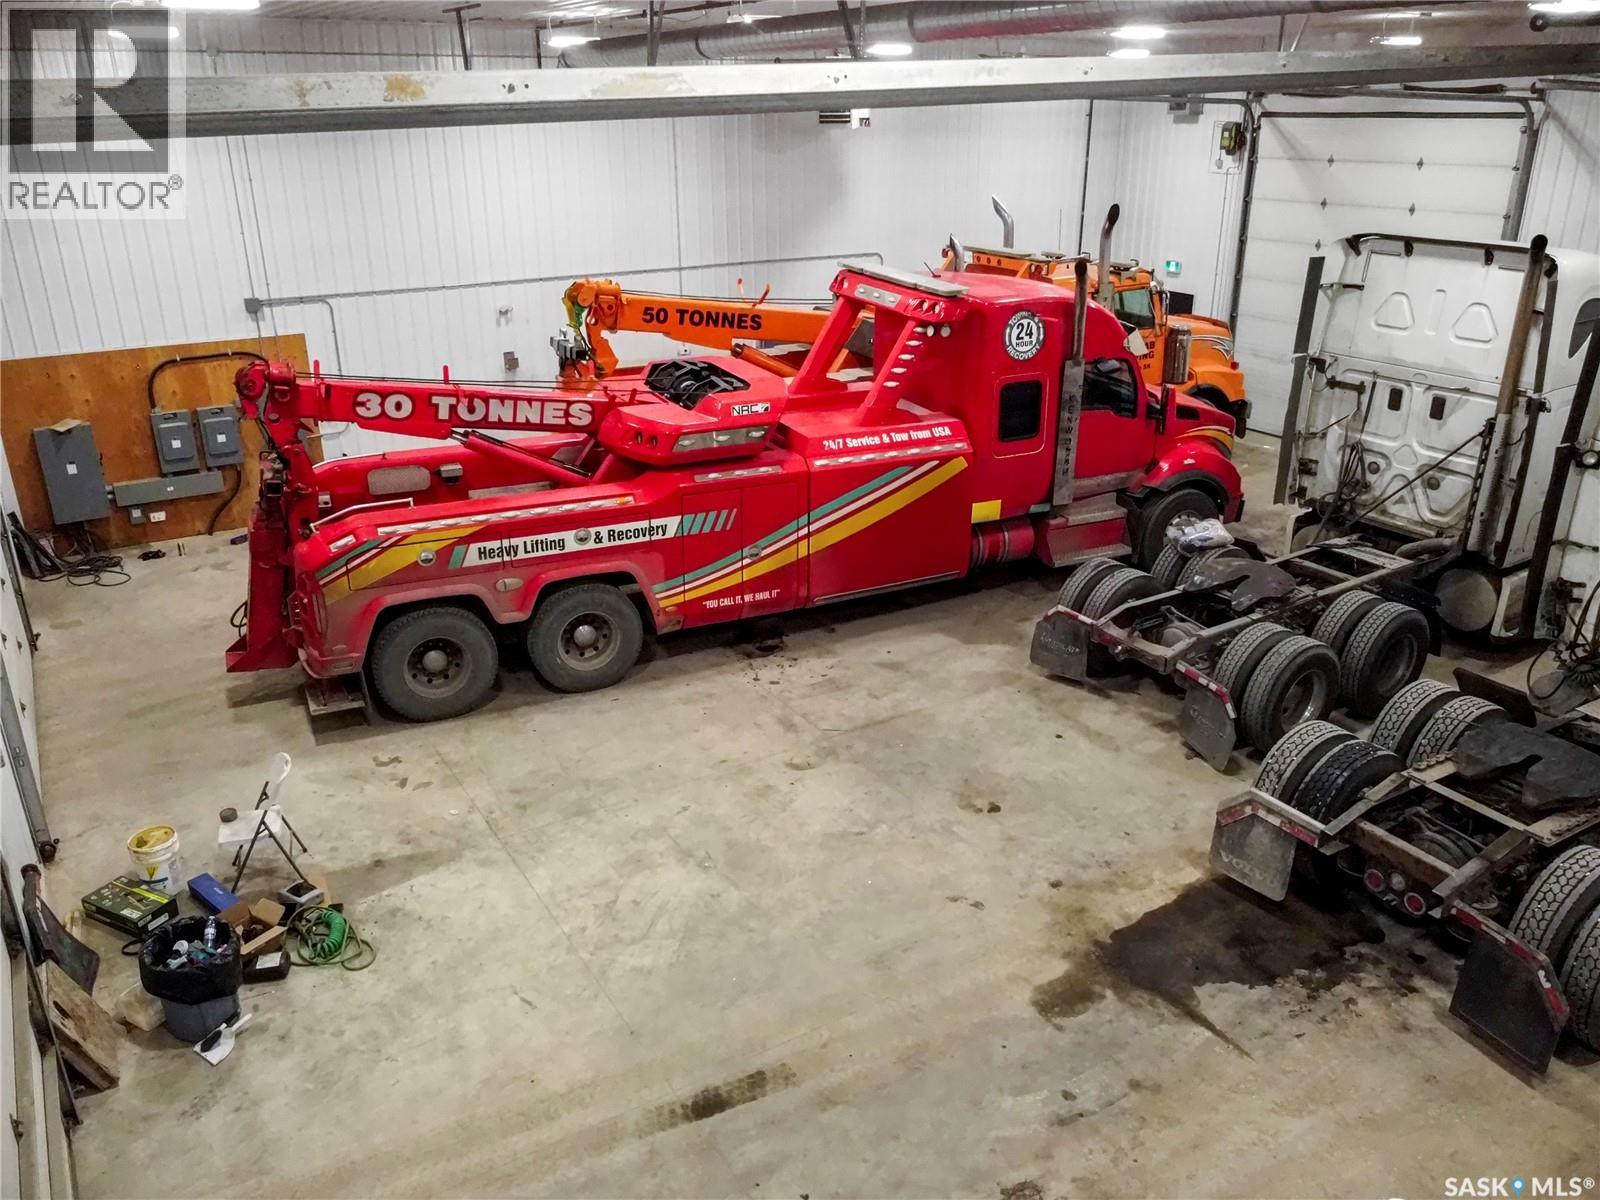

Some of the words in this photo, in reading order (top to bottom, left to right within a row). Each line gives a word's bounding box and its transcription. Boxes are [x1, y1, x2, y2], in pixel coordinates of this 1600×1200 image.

[642, 307, 669, 324] 50
[676, 308, 763, 330] TONNES
[1016, 321, 1034, 340] 24
[1006, 343, 1040, 360] RECOVERY
[1016, 340, 1034, 348] HOUR
[355, 393, 413, 419] 30
[432, 395, 593, 426] TONNES
[732, 404, 759, 416] NRC
[823, 438, 843, 450] 24/7
[846, 435, 881, 448] Service
[882, 433, 889, 443] &
[890, 431, 909, 442] Tow
[909, 429, 932, 440] from
[932, 426, 952, 437] USA
[478, 543, 519, 561] Heavy
[523, 537, 566, 554] Lifting
[593, 531, 603, 544] &
[607, 524, 668, 543] Recovery
[720, 597, 735, 606] CALL
[743, 593, 754, 603] WE
[755, 591, 770, 601] HAUL
